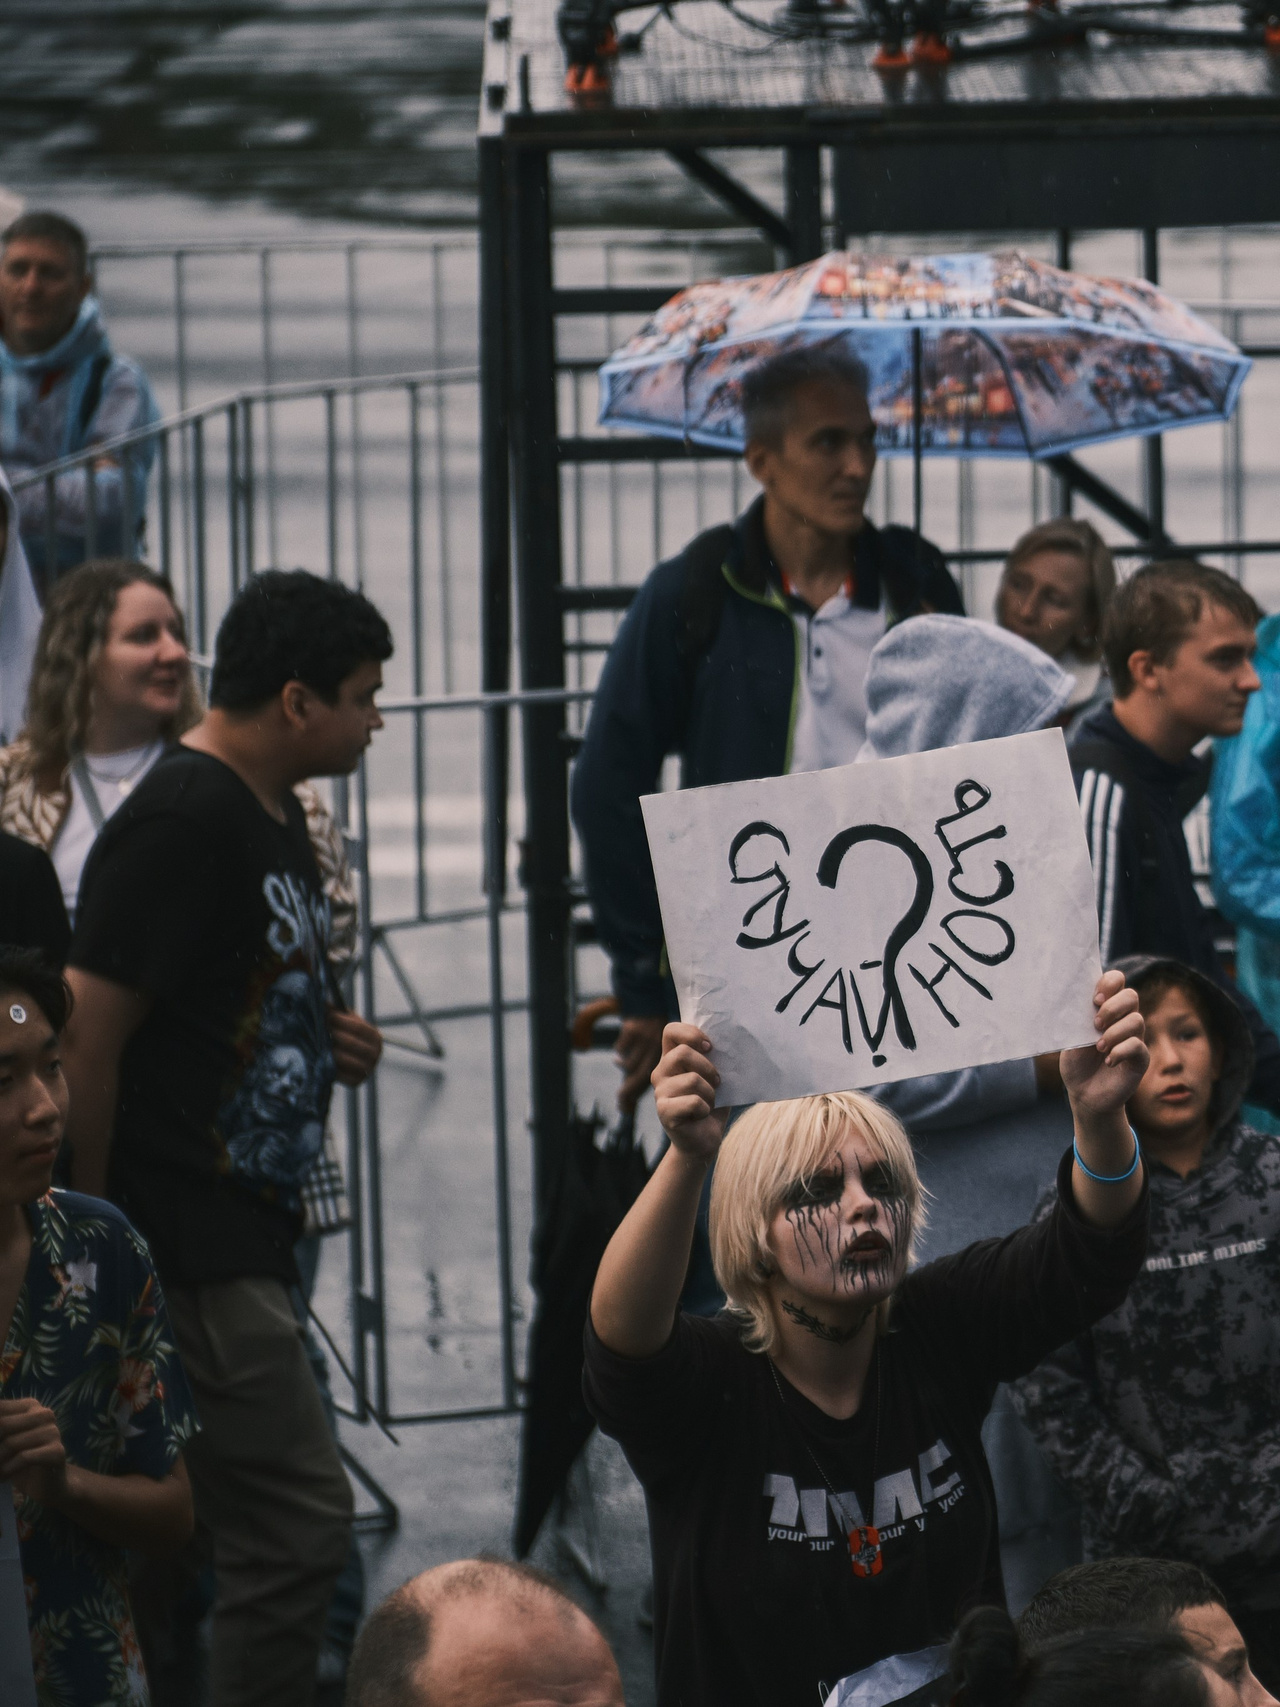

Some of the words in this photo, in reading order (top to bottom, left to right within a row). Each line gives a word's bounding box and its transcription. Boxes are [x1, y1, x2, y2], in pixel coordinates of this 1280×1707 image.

[729, 778, 1016, 1055] СЛУЧАЙНОСТЬ
[767, 1526, 808, 1543] your
[878, 1524, 906, 1543] our
